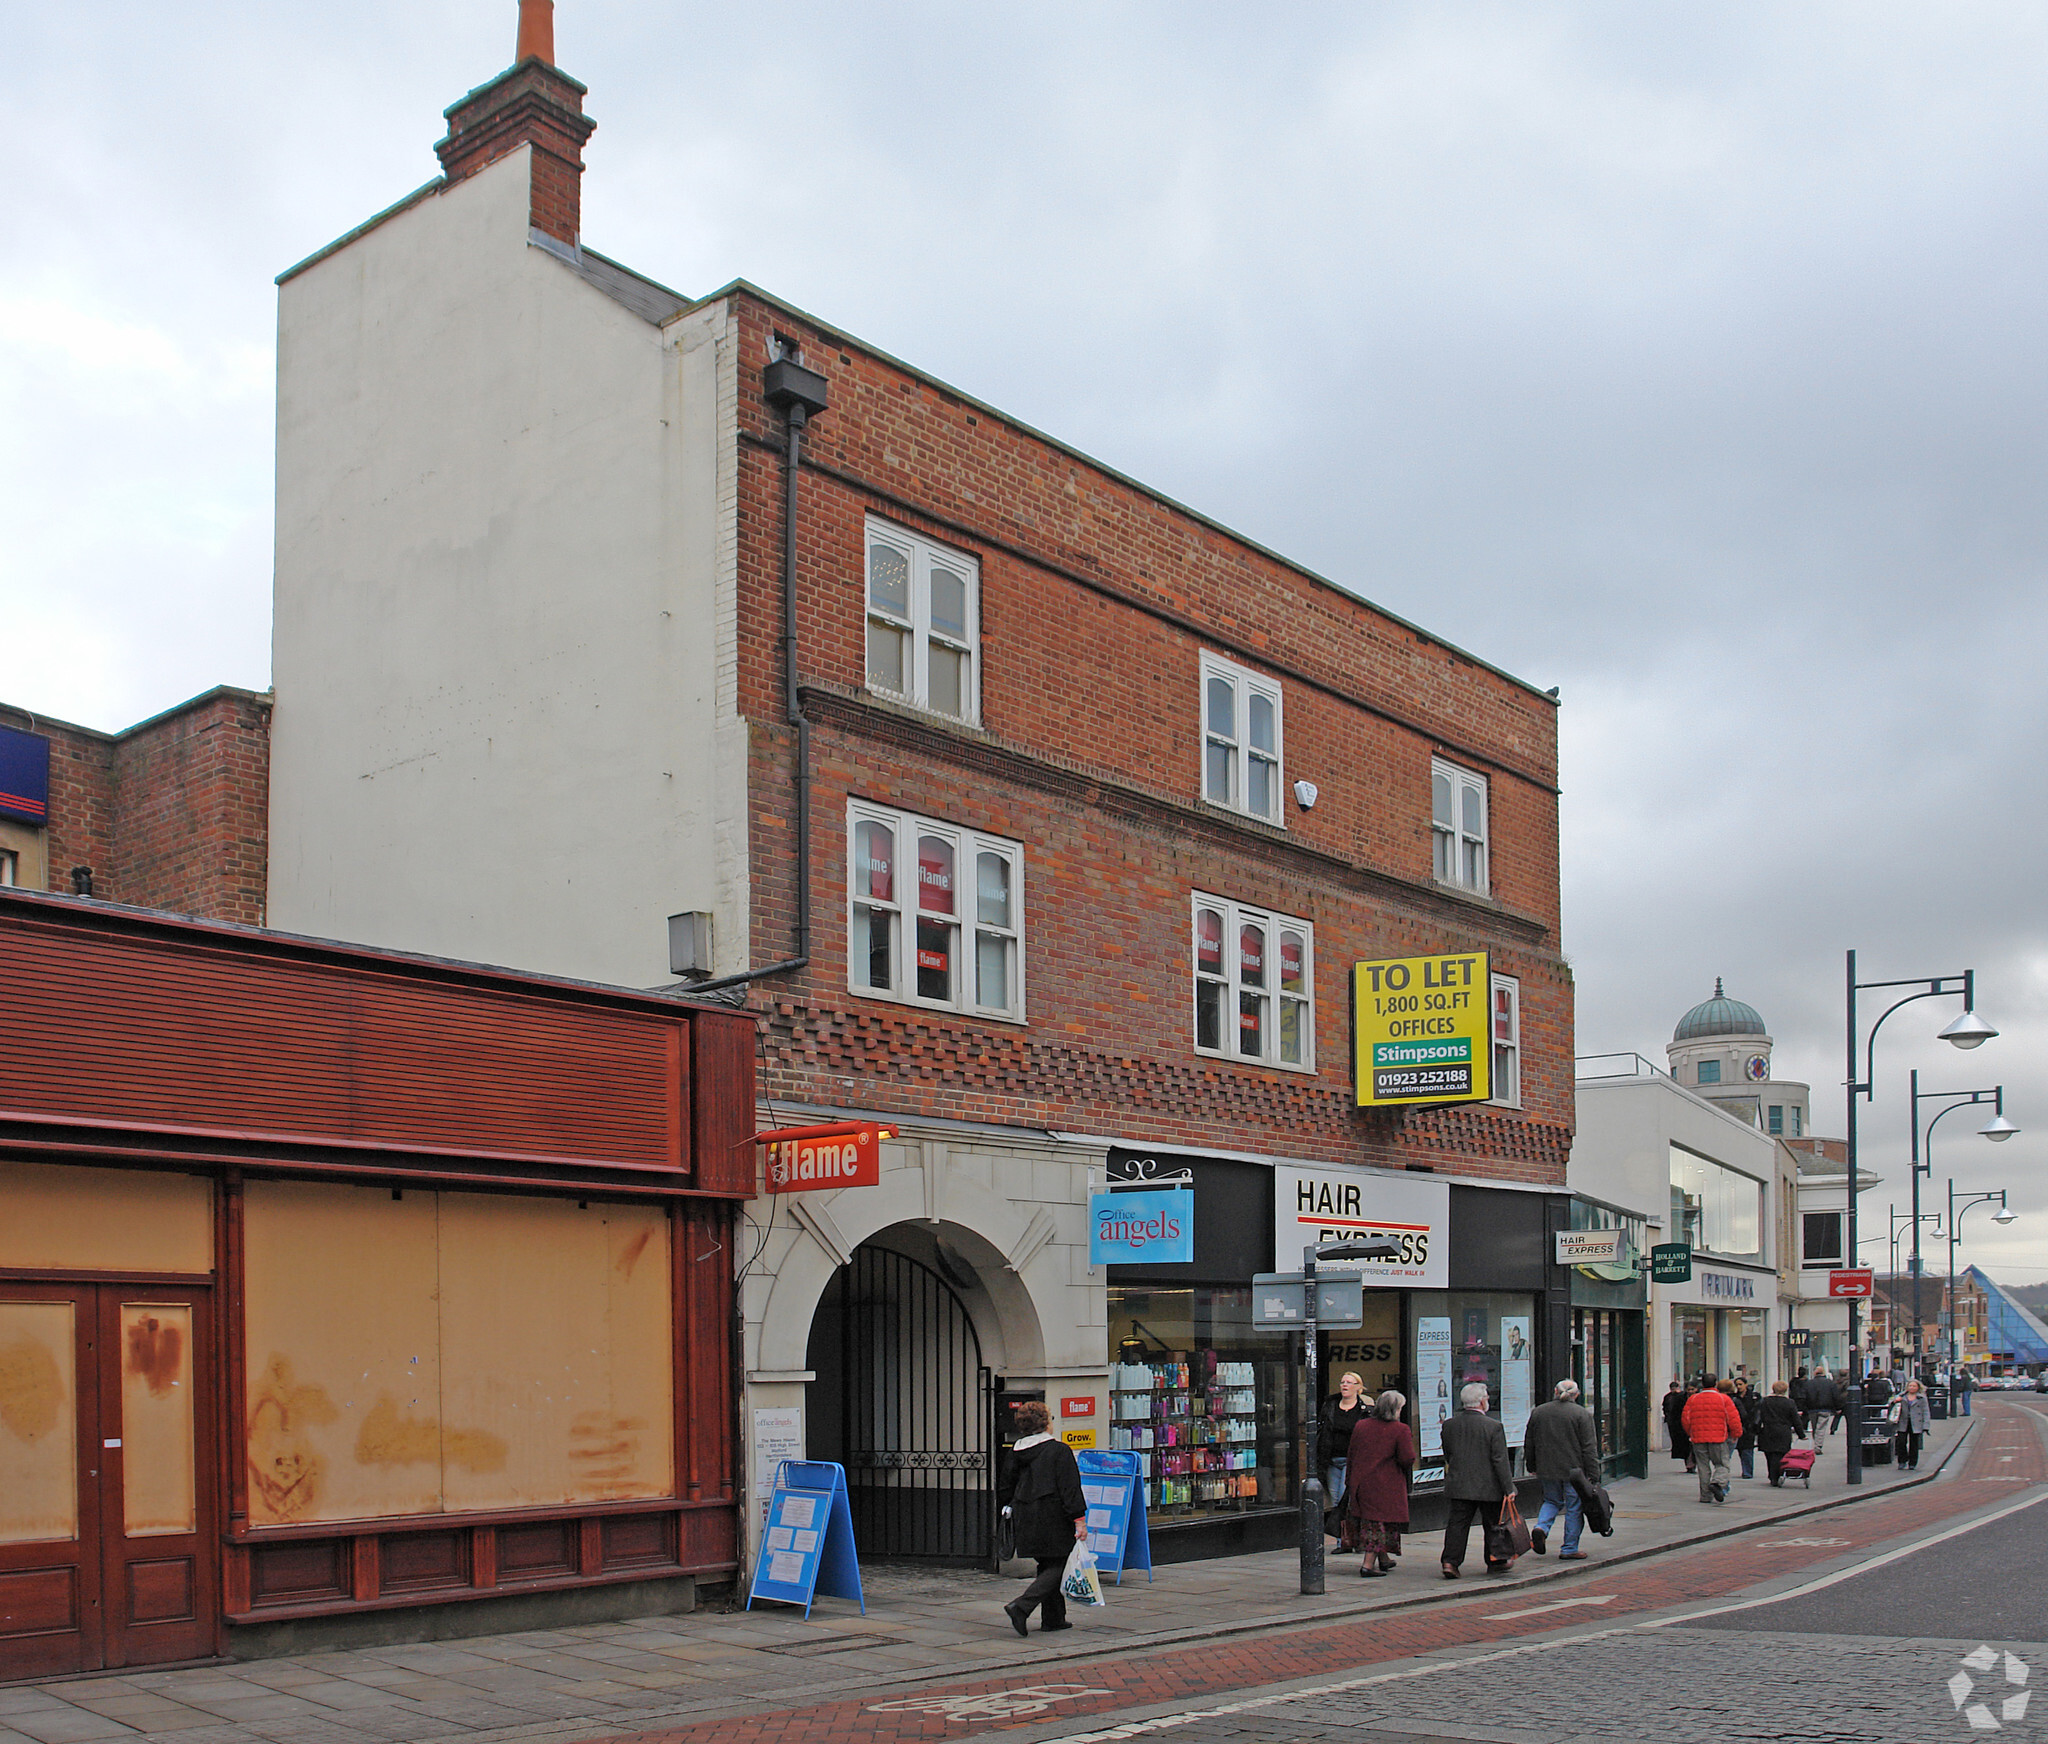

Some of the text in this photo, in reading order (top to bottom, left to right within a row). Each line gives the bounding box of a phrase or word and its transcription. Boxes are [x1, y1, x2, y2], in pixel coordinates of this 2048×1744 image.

[919, 865, 949, 888] flame
[919, 952, 941, 967] flame
[1367, 958, 1476, 992] TO LET
[1375, 992, 1470, 1017] 1,800 SQ.FT
[1389, 1017, 1455, 1037] OFFICES
[1377, 1045, 1467, 1063] Stimpsons
[1378, 1069, 1468, 1086] 01923 252188
[1378, 1082, 1468, 1094] www.stimpsons.co.uk
[1297, 1179, 1361, 1216] HAIR
[1097, 1209, 1136, 1221] Office
[1100, 1210, 1180, 1248] angels
[1560, 1236, 1585, 1244] HAIR
[1568, 1245, 1614, 1255] EXPRESS
[1655, 1253, 1687, 1261] HOLLAND
[1667, 1259, 1674, 1267] &
[1655, 1266, 1686, 1275] BARRETT
[1702, 1273, 1754, 1298] PRIMARK
[1419, 1331, 1450, 1341] EXPRESS
[1789, 1333, 1807, 1345] GAP
[1069, 1401, 1091, 1413] flame
[1067, 1433, 1092, 1442] Grow.
